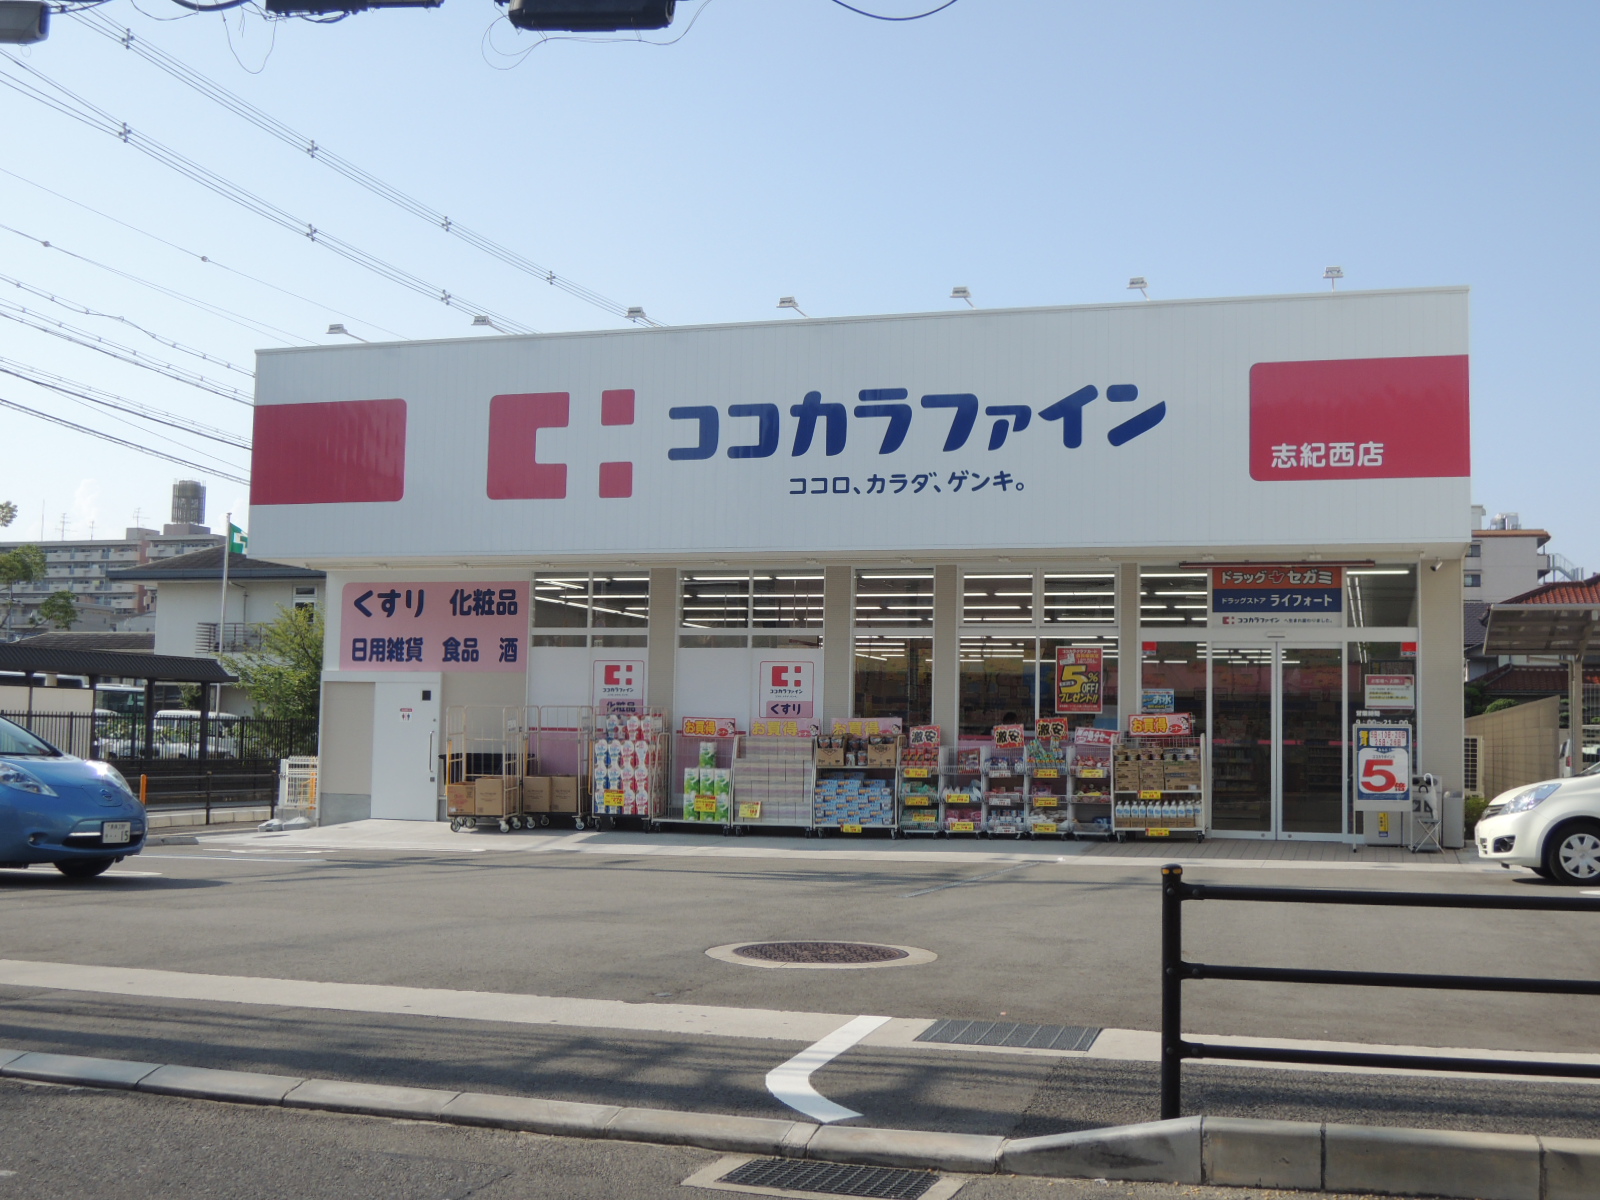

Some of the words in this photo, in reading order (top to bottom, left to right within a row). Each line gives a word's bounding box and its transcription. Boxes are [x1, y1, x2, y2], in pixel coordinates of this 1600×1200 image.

[668, 384, 1166, 460] ココカラファイン
[1271, 441, 1384, 468] 志紀西店
[789, 470, 1025, 494] ココロ、カラダ、ゲンキ。
[1287, 569, 1333, 584] セガミ
[354, 589, 425, 617] くすり
[449, 588, 518, 616] 化粧品
[1270, 594, 1333, 606] ライフォート
[352, 637, 423, 662] 日用雑貨
[442, 636, 479, 662] 食品
[499, 637, 518, 662] 酒
[606, 701, 636, 713] 化粧品
[770, 703, 801, 715] くすり
[684, 719, 716, 736] お買得
[752, 721, 798, 736] お買得
[1131, 717, 1168, 733] お買得
